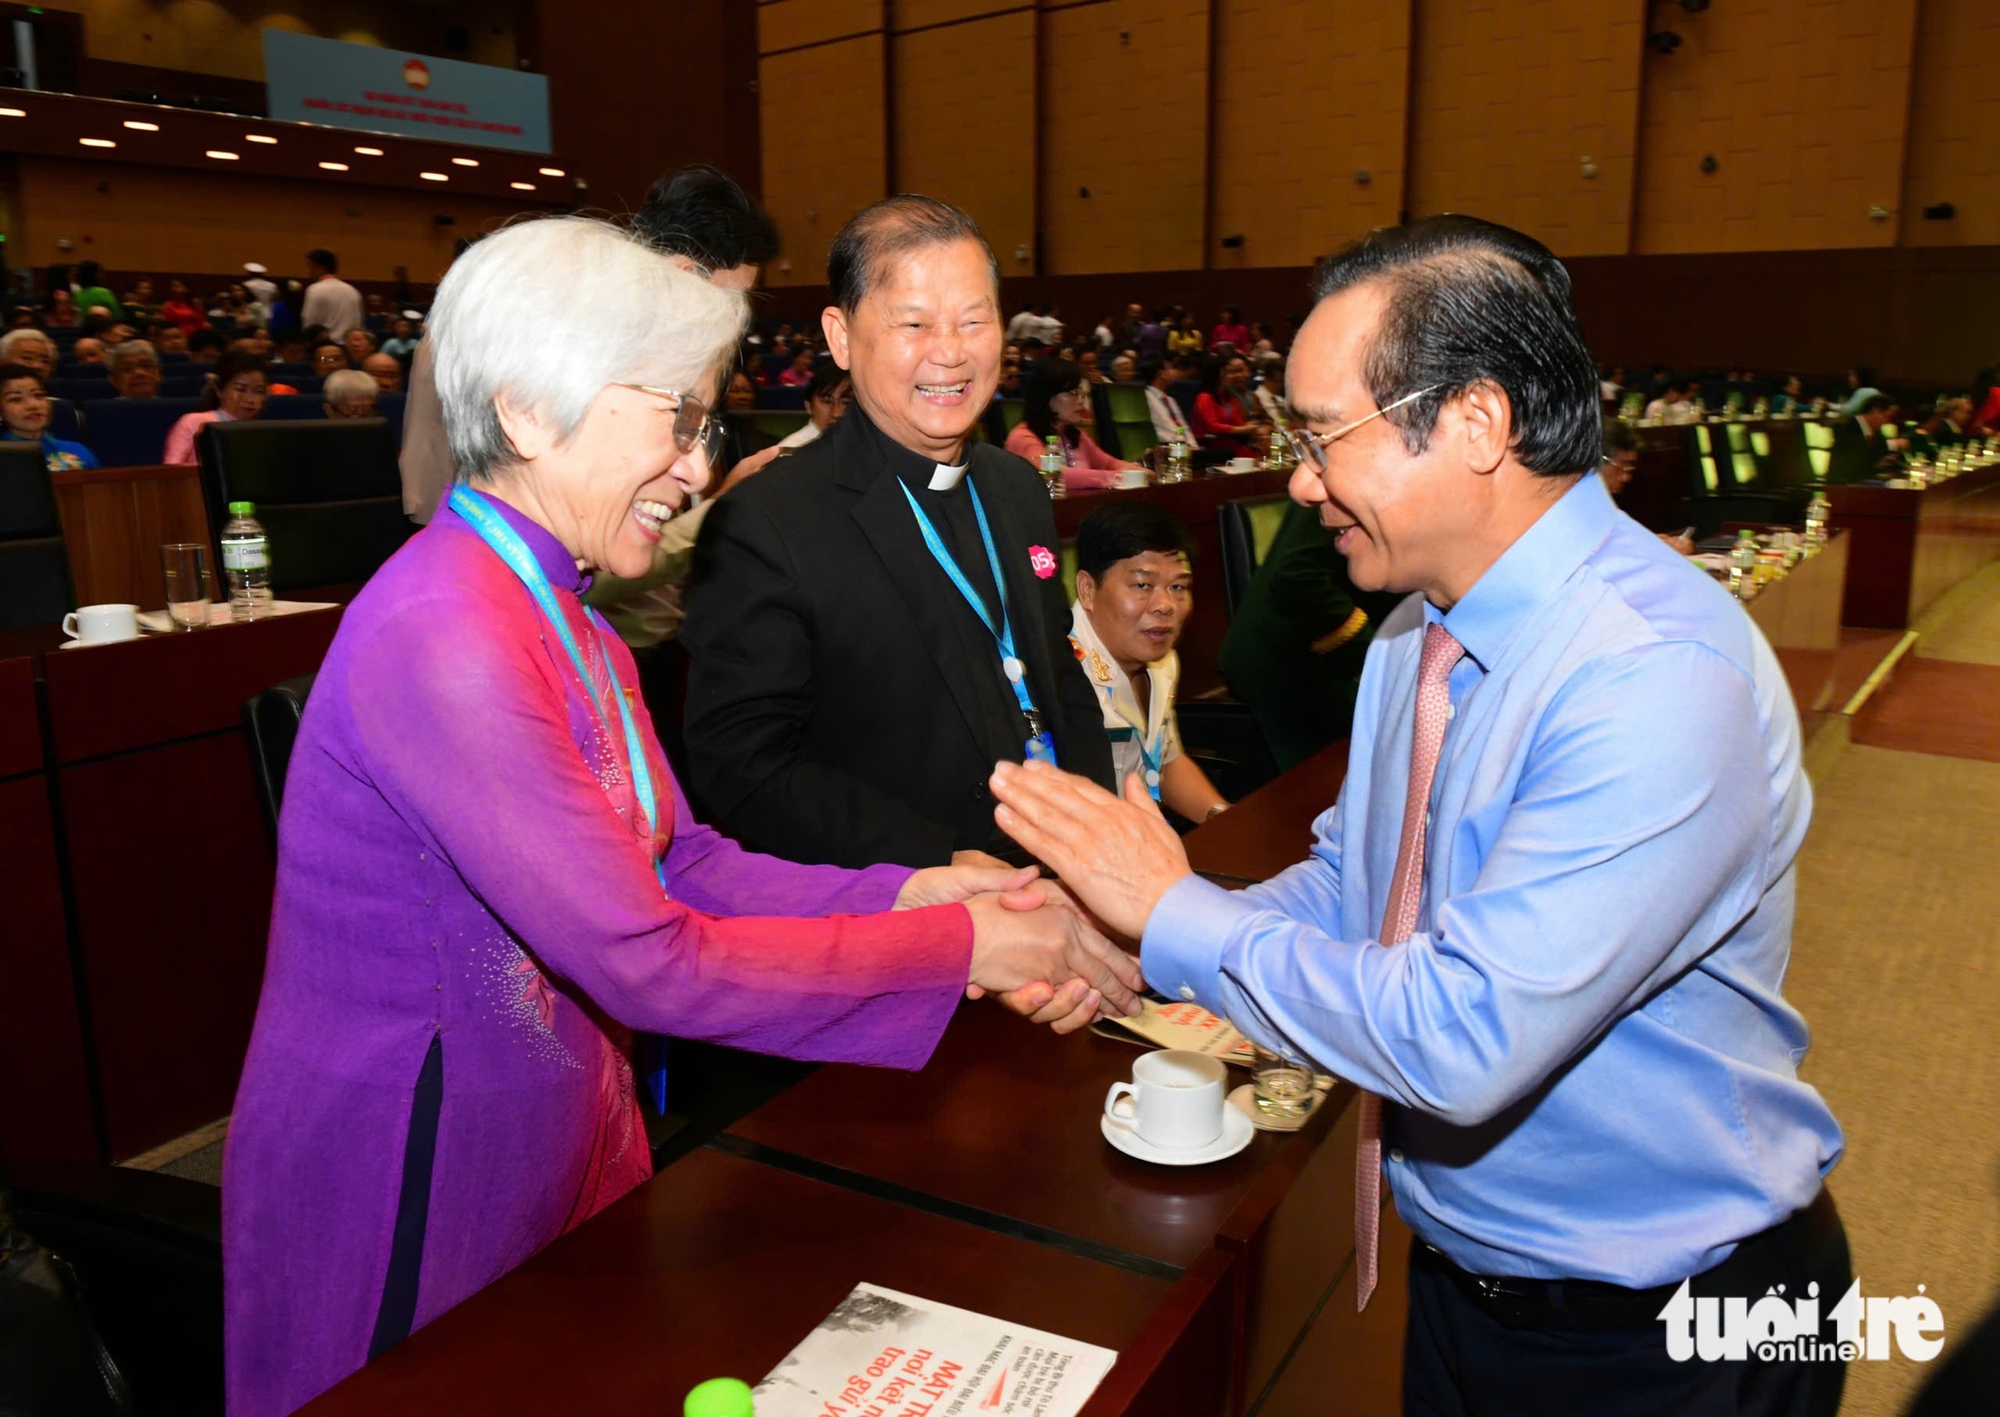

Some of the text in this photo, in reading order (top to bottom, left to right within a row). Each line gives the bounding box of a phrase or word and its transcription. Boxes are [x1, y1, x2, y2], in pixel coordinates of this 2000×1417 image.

[1031, 552, 1050, 571] 05
[865, 1345, 907, 1378] trao
[875, 1376, 916, 1405] kết
[896, 1359, 963, 1417] MẶT TR
